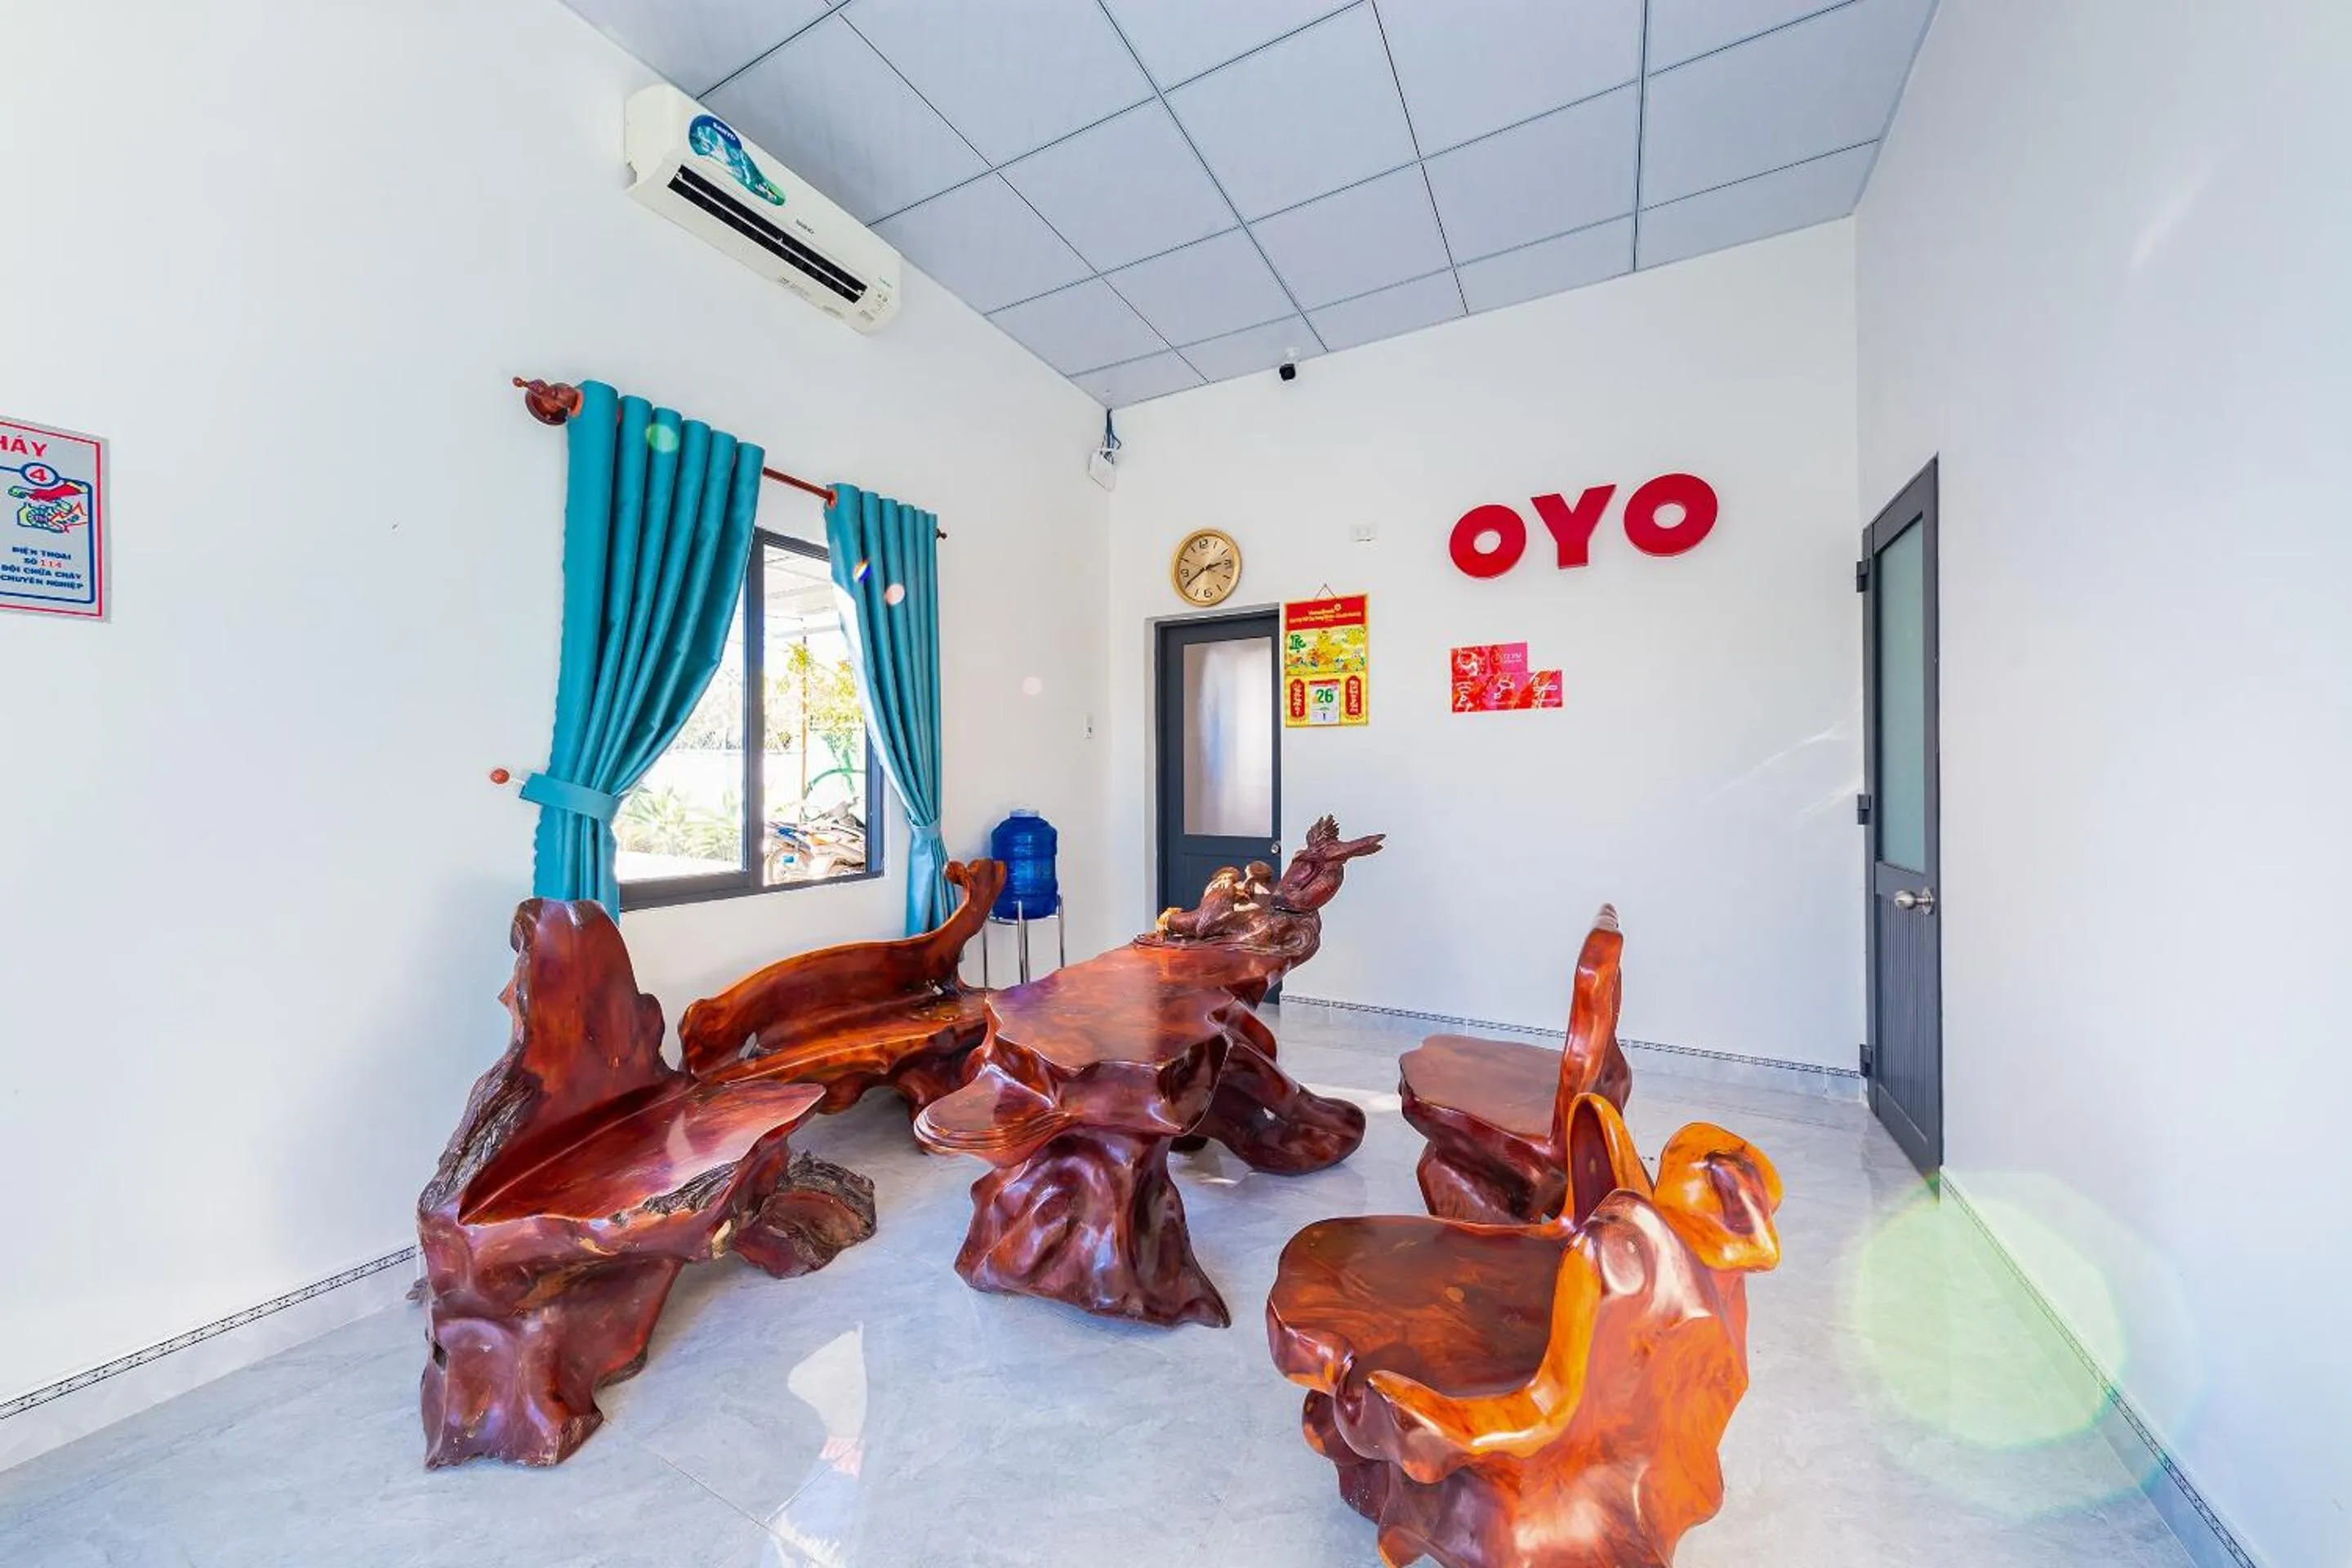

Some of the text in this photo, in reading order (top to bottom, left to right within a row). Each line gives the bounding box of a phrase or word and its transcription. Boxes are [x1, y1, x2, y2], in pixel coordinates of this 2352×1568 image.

[29, 468, 47, 482] 4
[1450, 473, 1718, 580] OYO
[1199, 539, 1209, 549] 12
[1204, 588, 1213, 598] 6
[1316, 688, 1334, 703] 26
